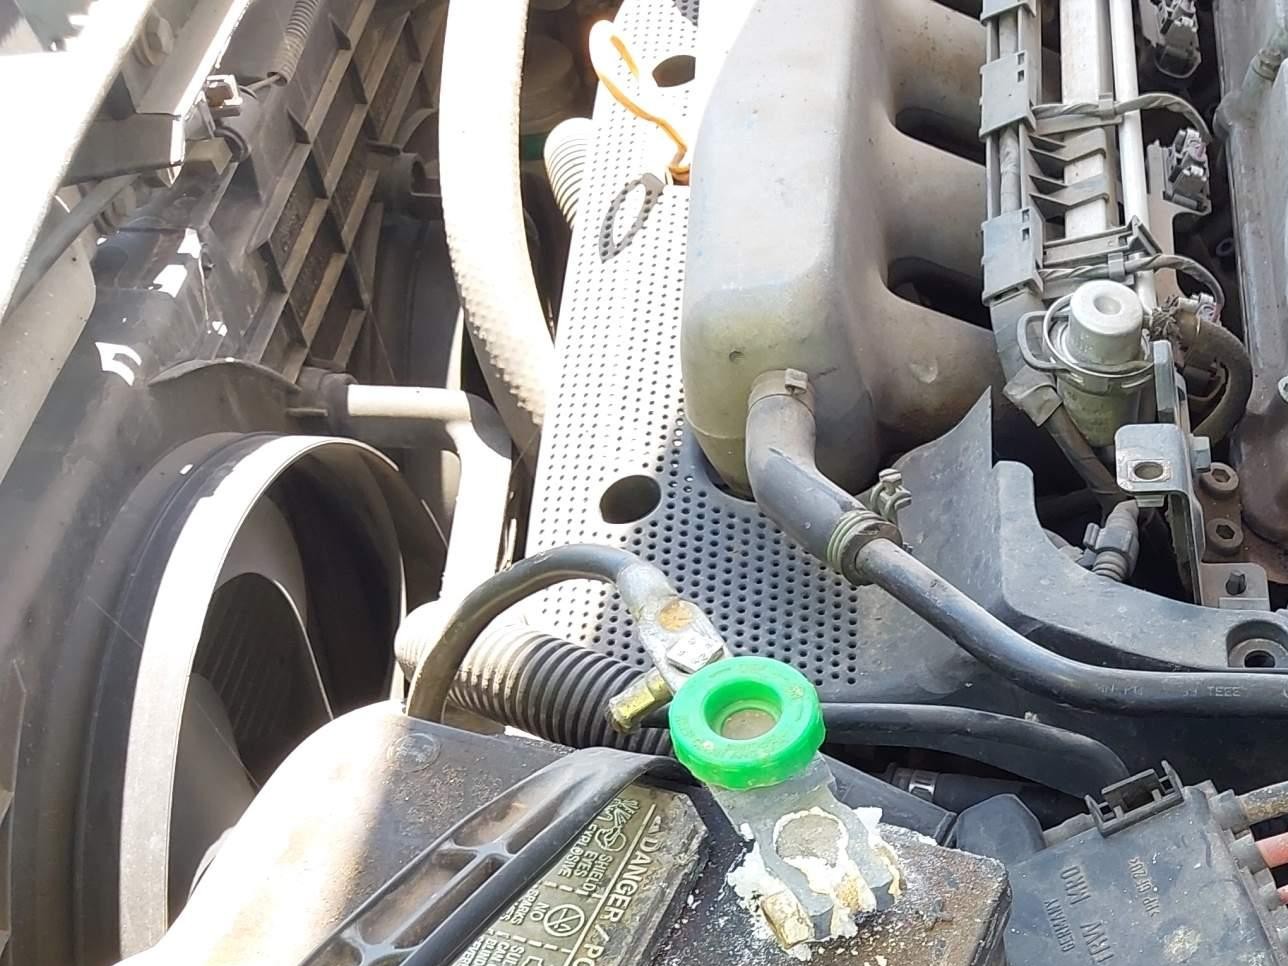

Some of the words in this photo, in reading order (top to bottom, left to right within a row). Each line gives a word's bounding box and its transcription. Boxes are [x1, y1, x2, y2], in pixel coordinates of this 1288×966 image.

[572, 850, 598, 877] EYES
[579, 853, 613, 892] SHIELD
[597, 837, 663, 923] DANGER
[1060, 865, 1091, 905] MRO
[508, 888, 539, 926] SPARKS
[527, 901, 549, 921] NO
[1044, 899, 1075, 952] GERMANY
[489, 941, 510, 961] CAN
